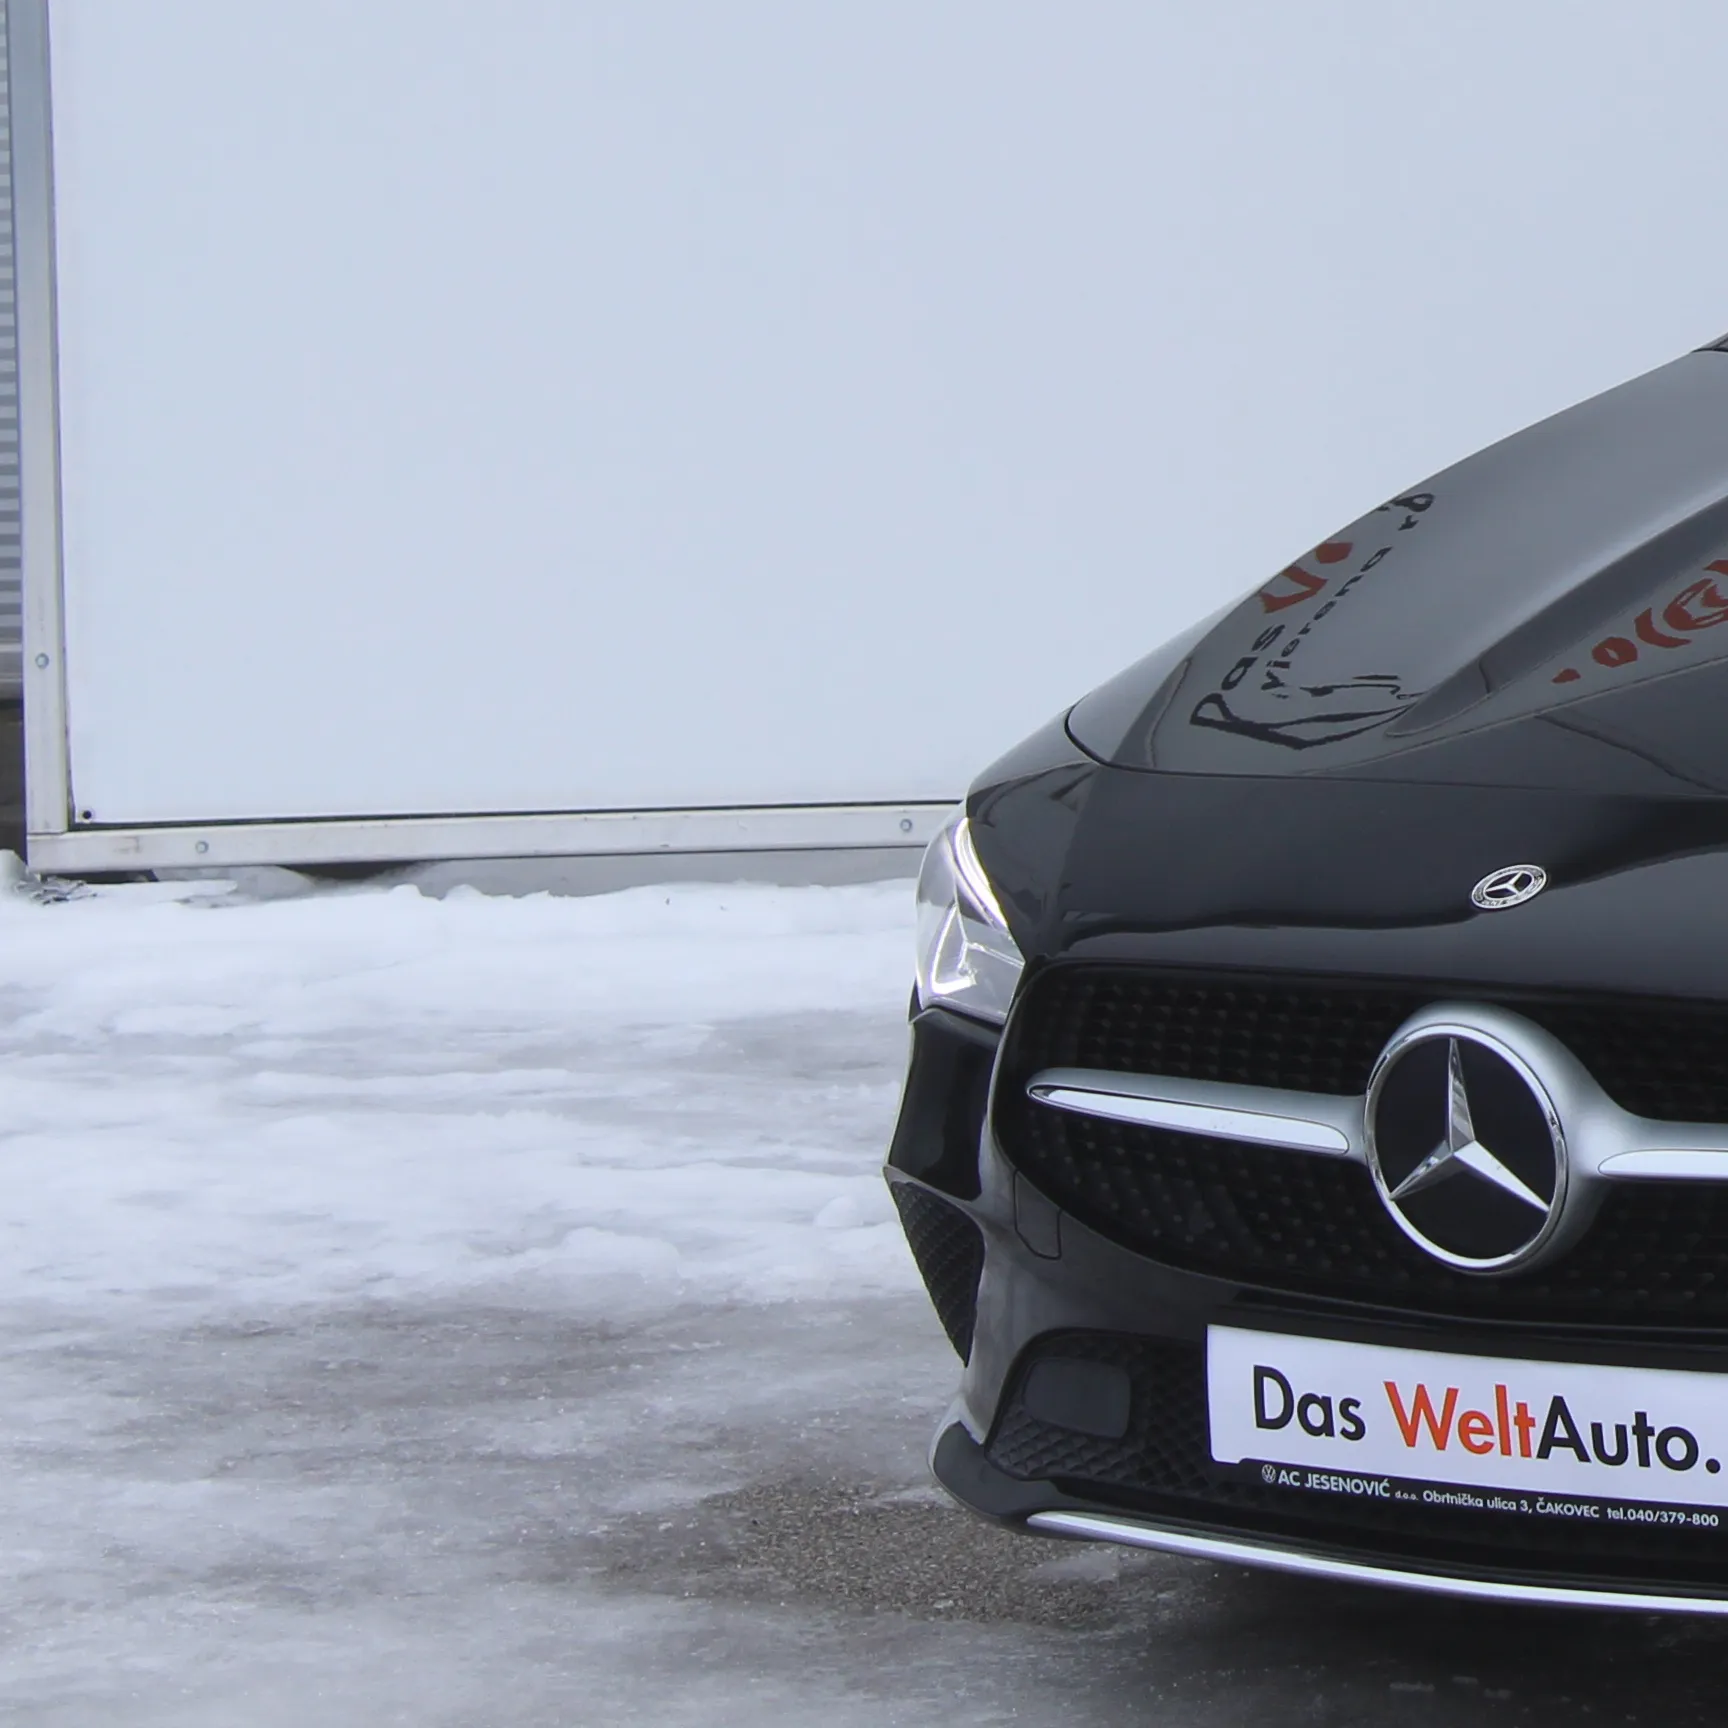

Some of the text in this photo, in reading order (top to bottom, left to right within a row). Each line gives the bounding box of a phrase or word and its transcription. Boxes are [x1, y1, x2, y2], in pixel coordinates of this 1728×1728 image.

[1252, 1364, 1721, 1473] Das WeltAuto.
[1277, 1469, 1300, 1487] AC
[1304, 1473, 1391, 1498] JESENOVIĆ
[1422, 1489, 1483, 1508] Obrtnička
[1487, 1497, 1516, 1511] ulica
[1519, 1499, 1533, 1514] 3,
[1535, 1496, 1600, 1518] ČAKOVEC
[1606, 1507, 1720, 1527] tel.040/379-800
